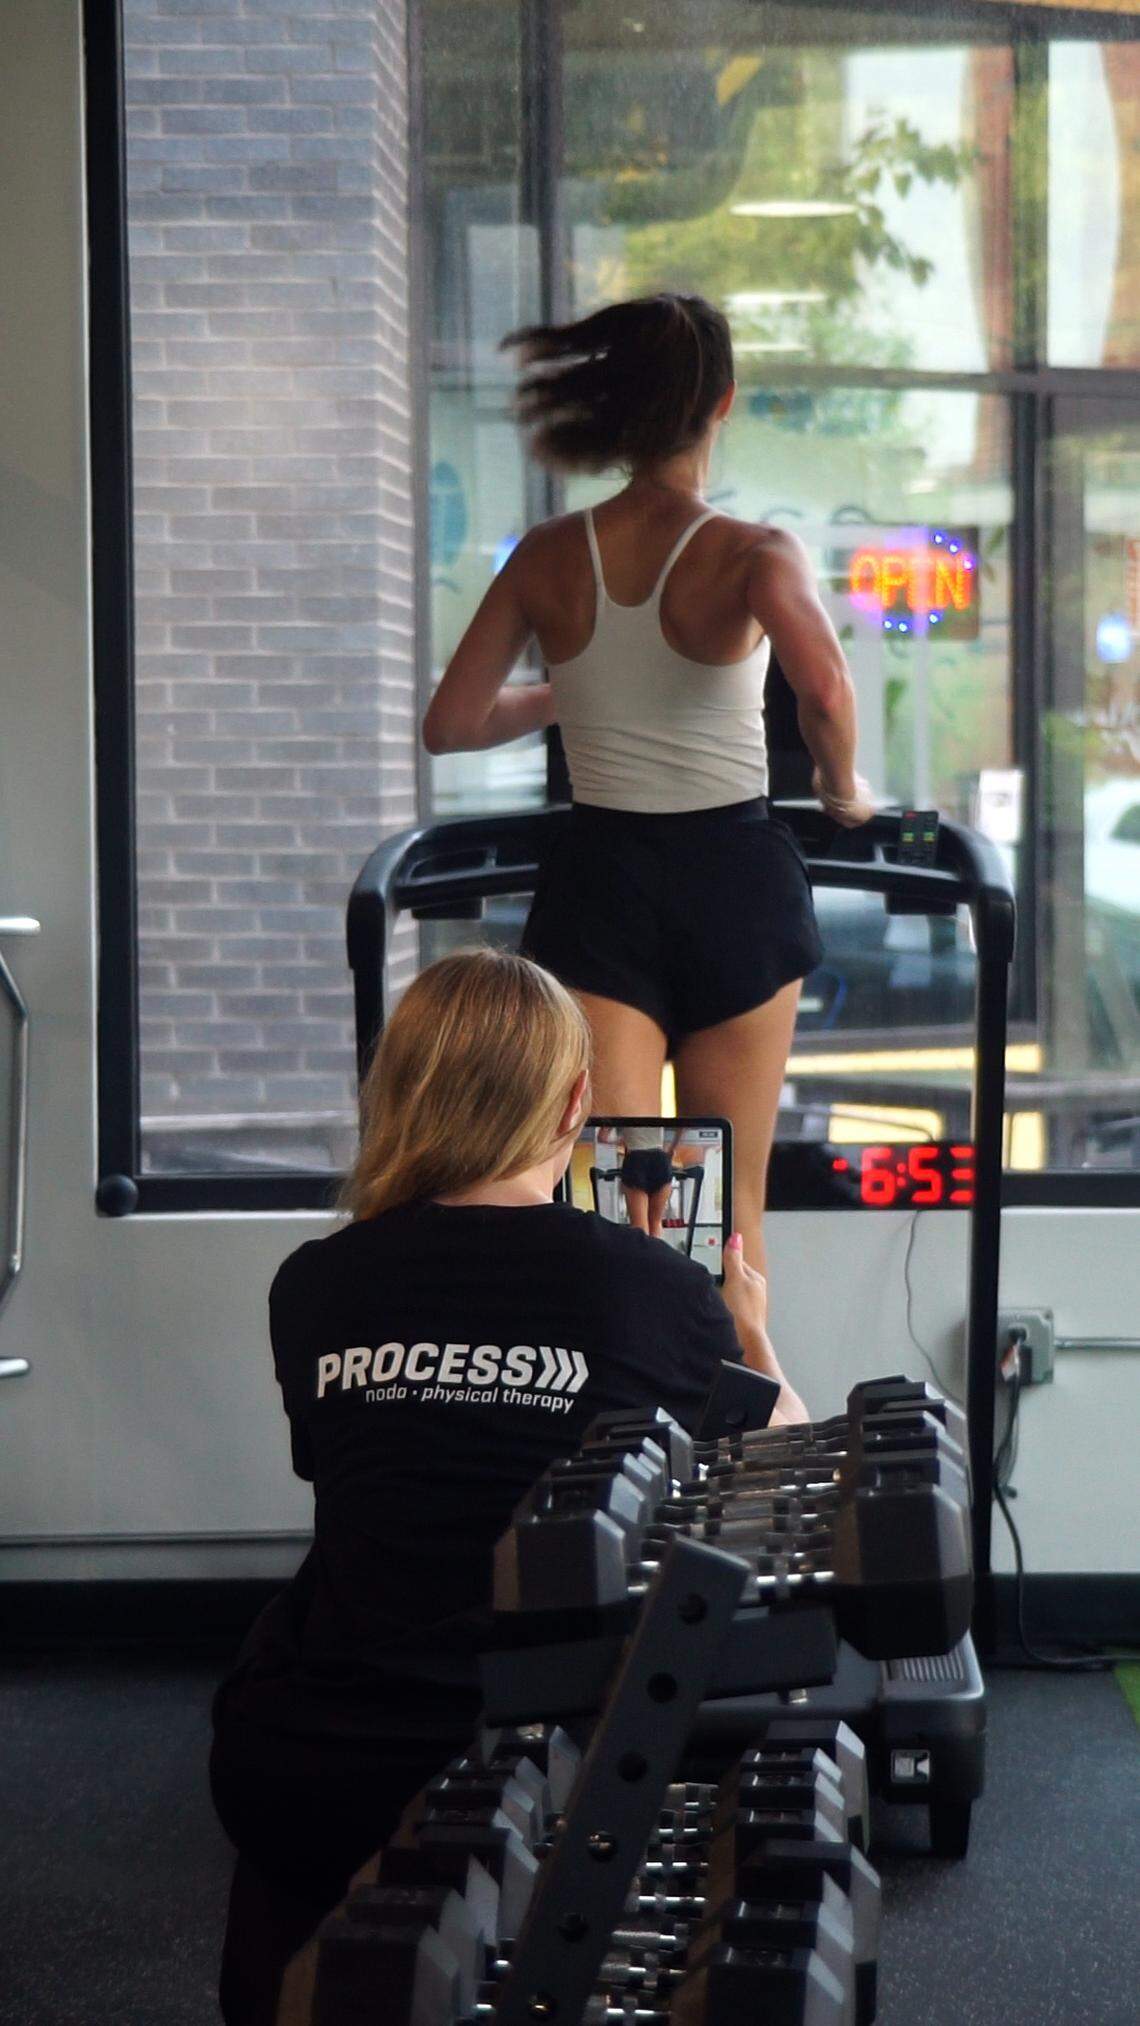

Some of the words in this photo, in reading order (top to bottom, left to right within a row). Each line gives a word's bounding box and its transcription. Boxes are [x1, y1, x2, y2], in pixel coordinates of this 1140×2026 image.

[850, 550, 971, 612] OPEN
[317, 1342, 537, 1398] PROCESS
[365, 1383, 408, 1402] noda
[421, 1384, 498, 1403] physical
[502, 1388, 574, 1414] therapy
